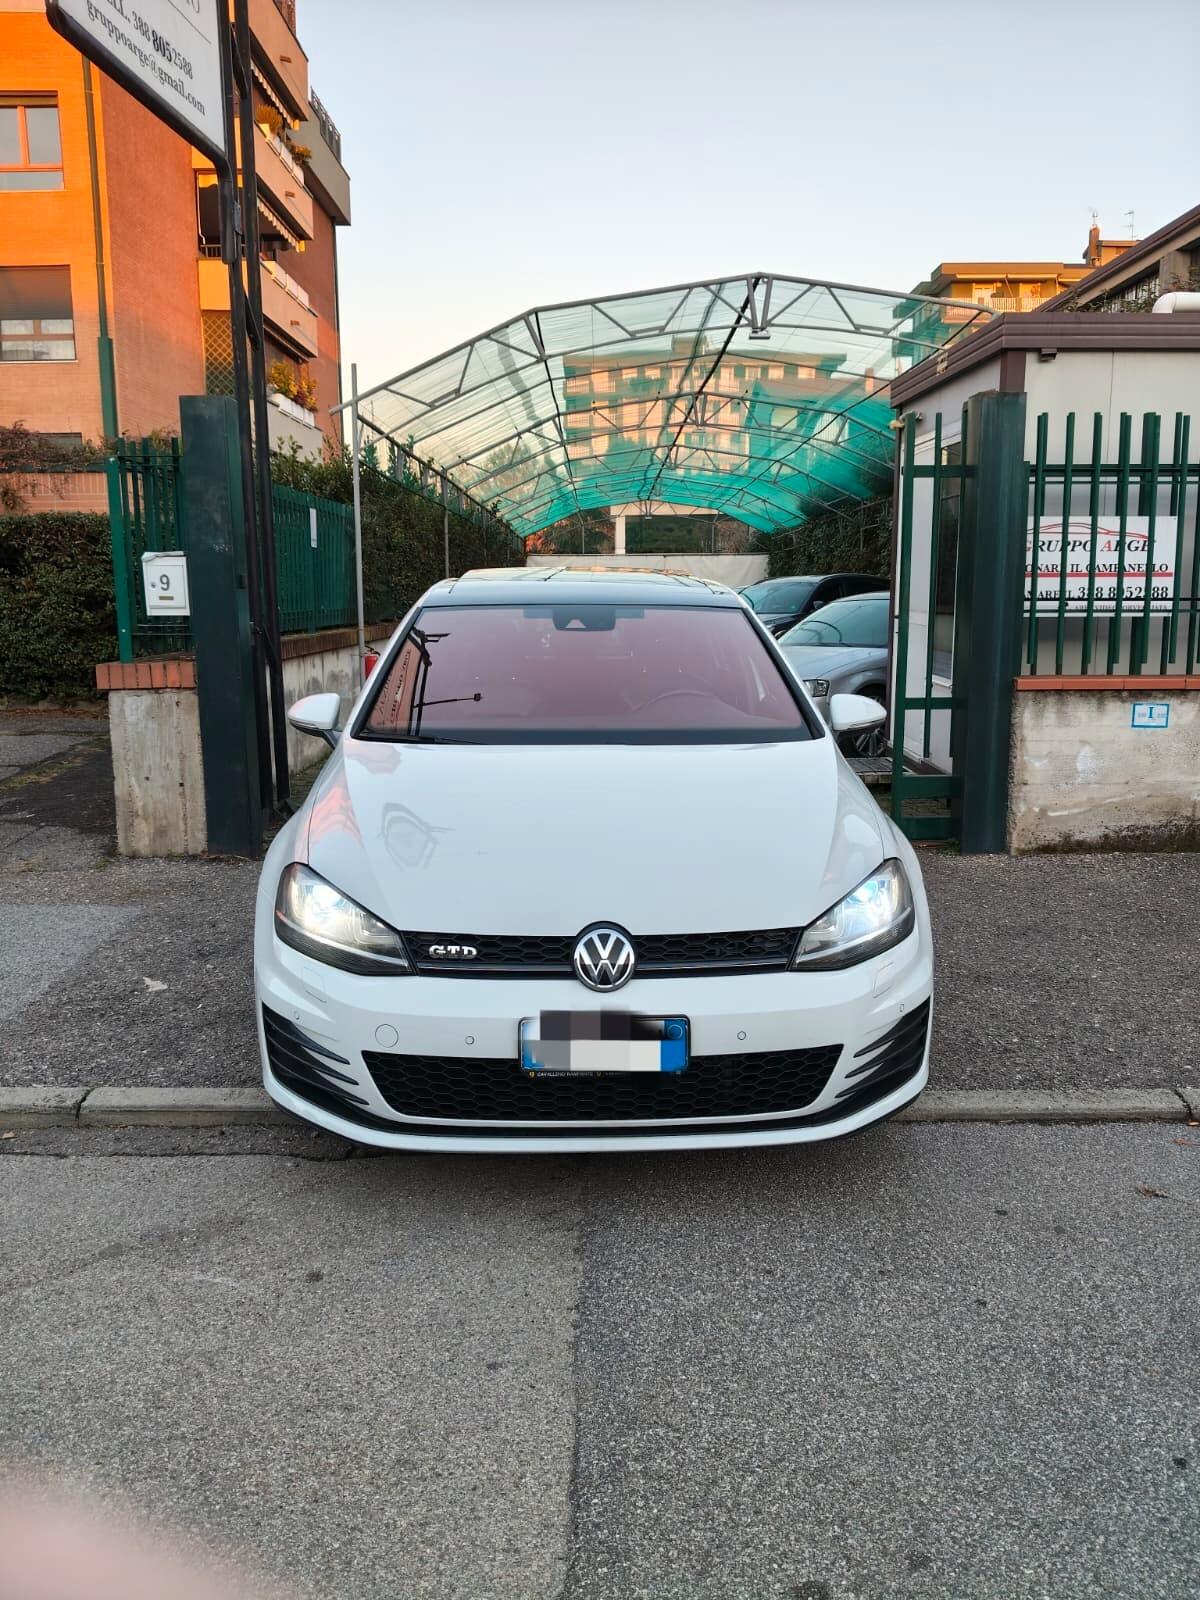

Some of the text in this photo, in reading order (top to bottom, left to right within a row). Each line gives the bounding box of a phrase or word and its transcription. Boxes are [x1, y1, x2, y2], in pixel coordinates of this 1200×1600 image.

[132, 10, 151, 42] 388
[152, 29, 194, 80] 8052588
[1070, 563, 1083, 573] IL
[1085, 563, 1169, 573] CAMPNELO
[159, 574, 171, 592] 9
[1078, 586, 1104, 599] 38
[1108, 586, 1169, 599] 85288
[429, 945, 477, 960] GTD
